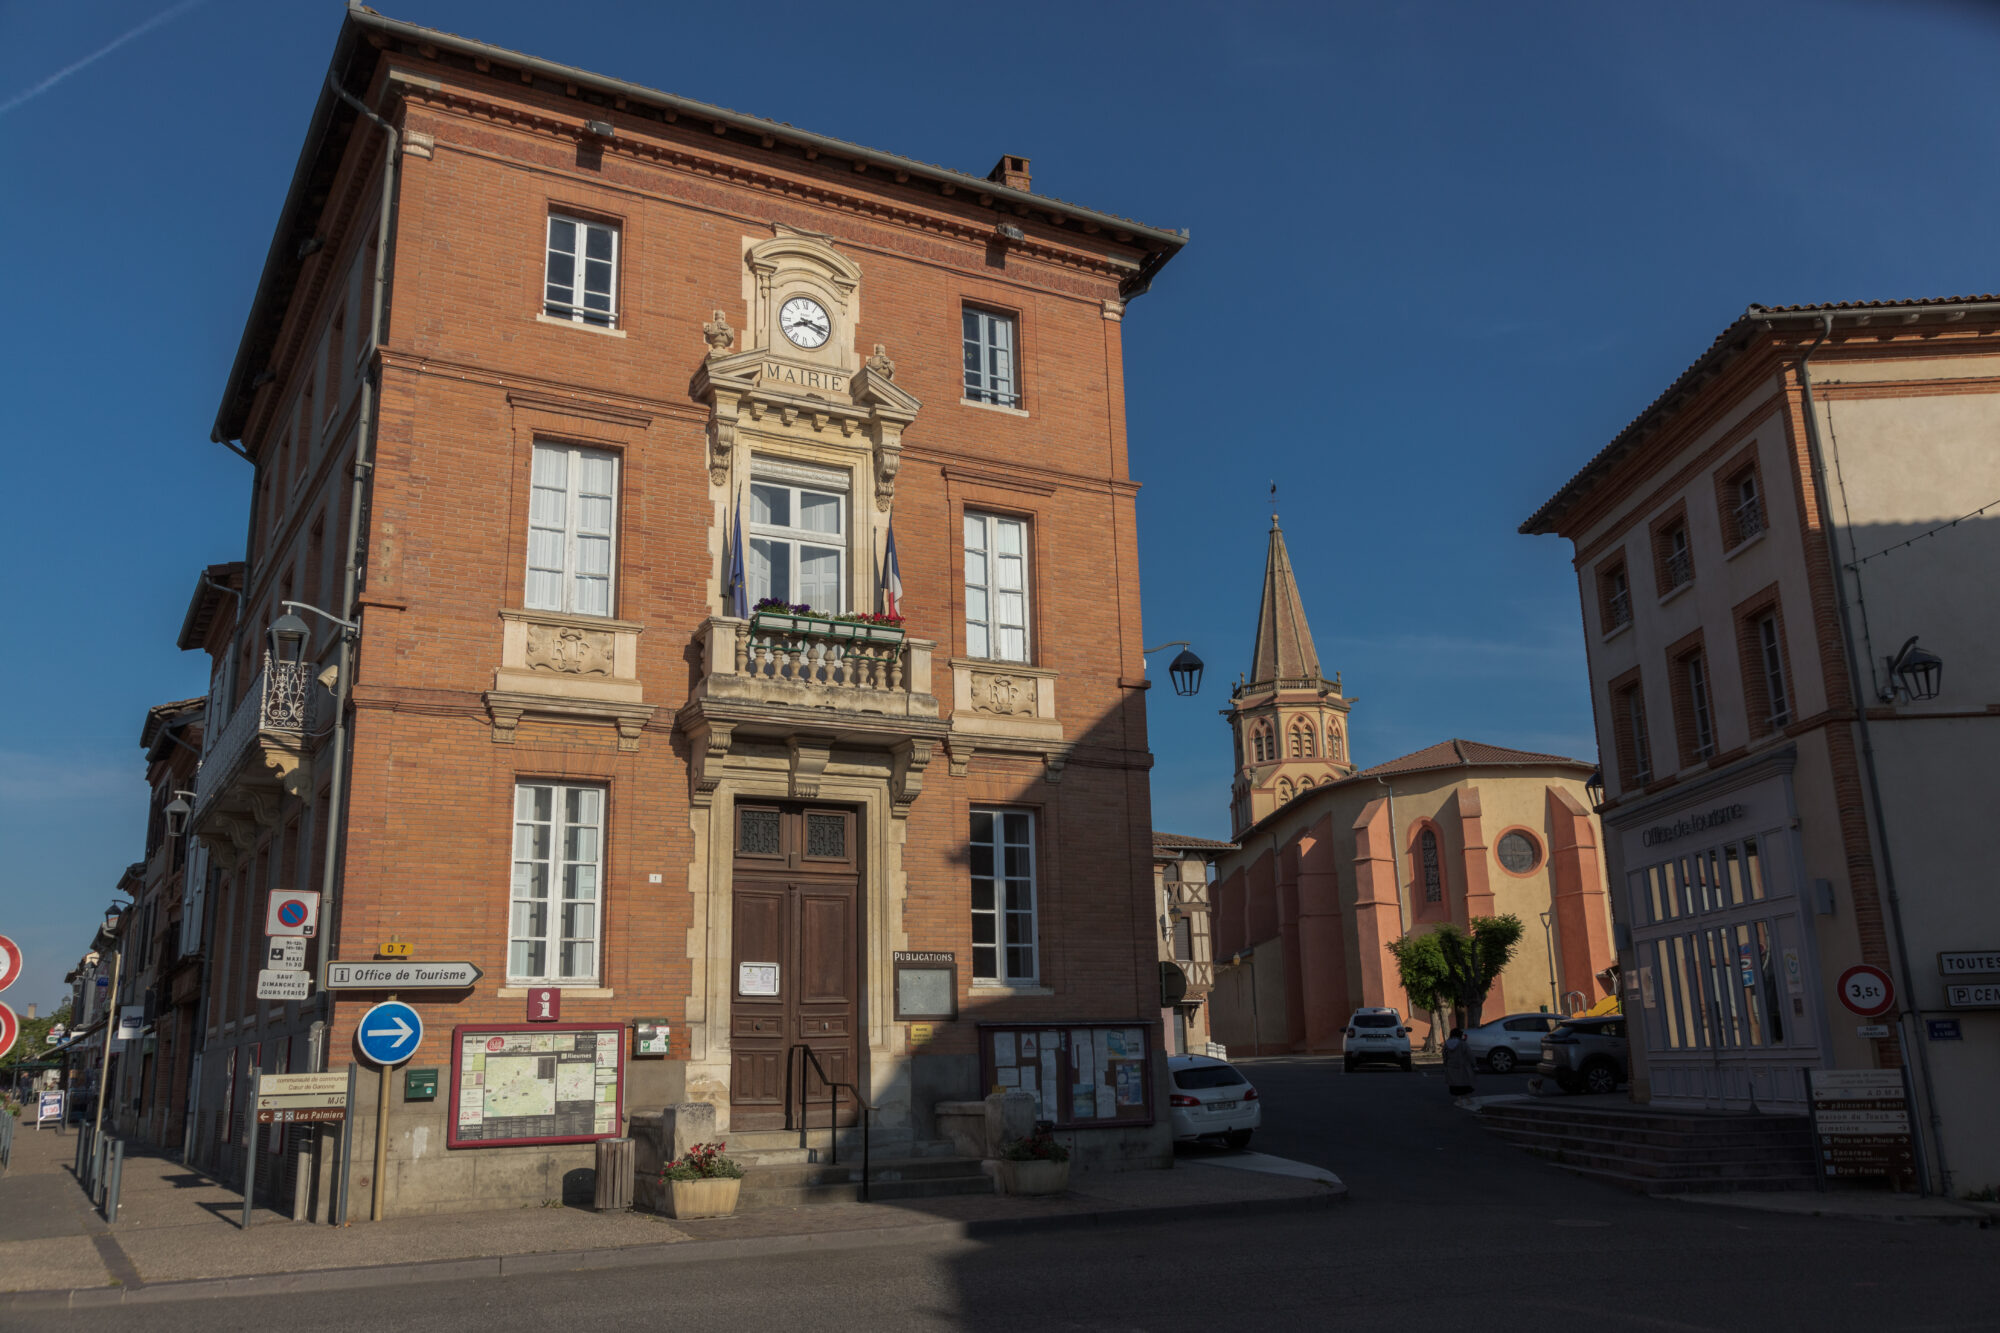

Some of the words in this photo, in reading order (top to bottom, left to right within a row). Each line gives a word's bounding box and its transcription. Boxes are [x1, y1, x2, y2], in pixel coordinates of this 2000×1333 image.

[767, 363, 843, 392] MAIRIE
[1673, 819, 1690, 838] de
[387, 944, 394, 953] D
[400, 944, 406, 953] 7
[894, 952, 953, 962] PUBLICATIONS
[354, 969, 392, 981] Office
[396, 969, 410, 981] de
[415, 969, 467, 980] Tourisme
[327, 1096, 345, 1104] MJC
[296, 1112, 308, 1120] Les
[310, 1110, 344, 1120] Palmiers
